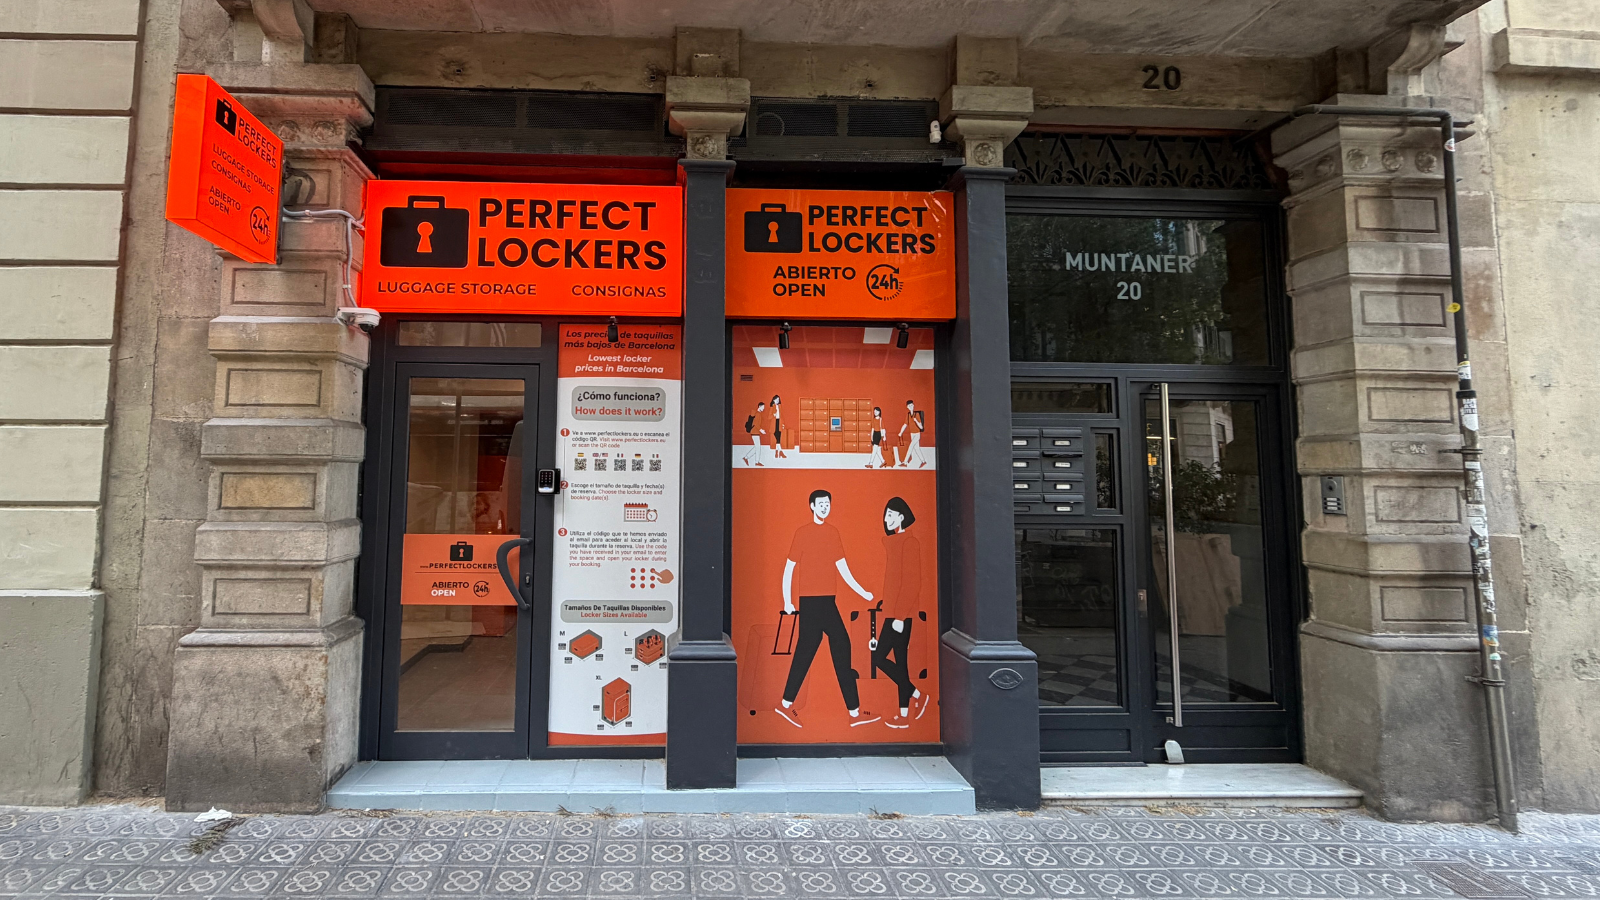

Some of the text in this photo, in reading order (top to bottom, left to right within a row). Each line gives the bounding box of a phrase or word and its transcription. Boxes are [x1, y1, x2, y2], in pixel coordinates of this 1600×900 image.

[1142, 64, 1181, 90] 20
[238, 116, 277, 156] PERFECT
[237, 129, 277, 169] LOCKERS
[211, 159, 252, 194] CONSIGNAS
[213, 143, 275, 196] LUGGAGE STORAGE
[208, 196, 230, 216] OPEN
[209, 185, 241, 211] ABIERTO
[479, 197, 657, 231] PERFECT
[808, 205, 928, 227] PERFECT
[252, 213, 269, 236] 24h
[808, 231, 936, 254] LOCKERS
[477, 237, 667, 271] LOCKERS
[1065, 252, 1193, 274] MUNTANER
[773, 265, 856, 280] ABIERTO
[870, 274, 899, 290] 24h
[377, 281, 667, 298] LUGGAGE STORAGE CONSIGNAS
[772, 283, 826, 297] OPEN
[1116, 282, 1142, 301] 20
[566, 330, 674, 340] Los preci de taquillas
[564, 340, 675, 350] más bajos de Barcelona
[588, 354, 652, 363] Lowest locker
[575, 364, 664, 373] prices in Barcelona
[577, 391, 660, 402] ¿Cómo funciona?
[575, 406, 663, 416] How does it work?
[431, 589, 456, 597] OPEN
[475, 584, 489, 593] 24h
